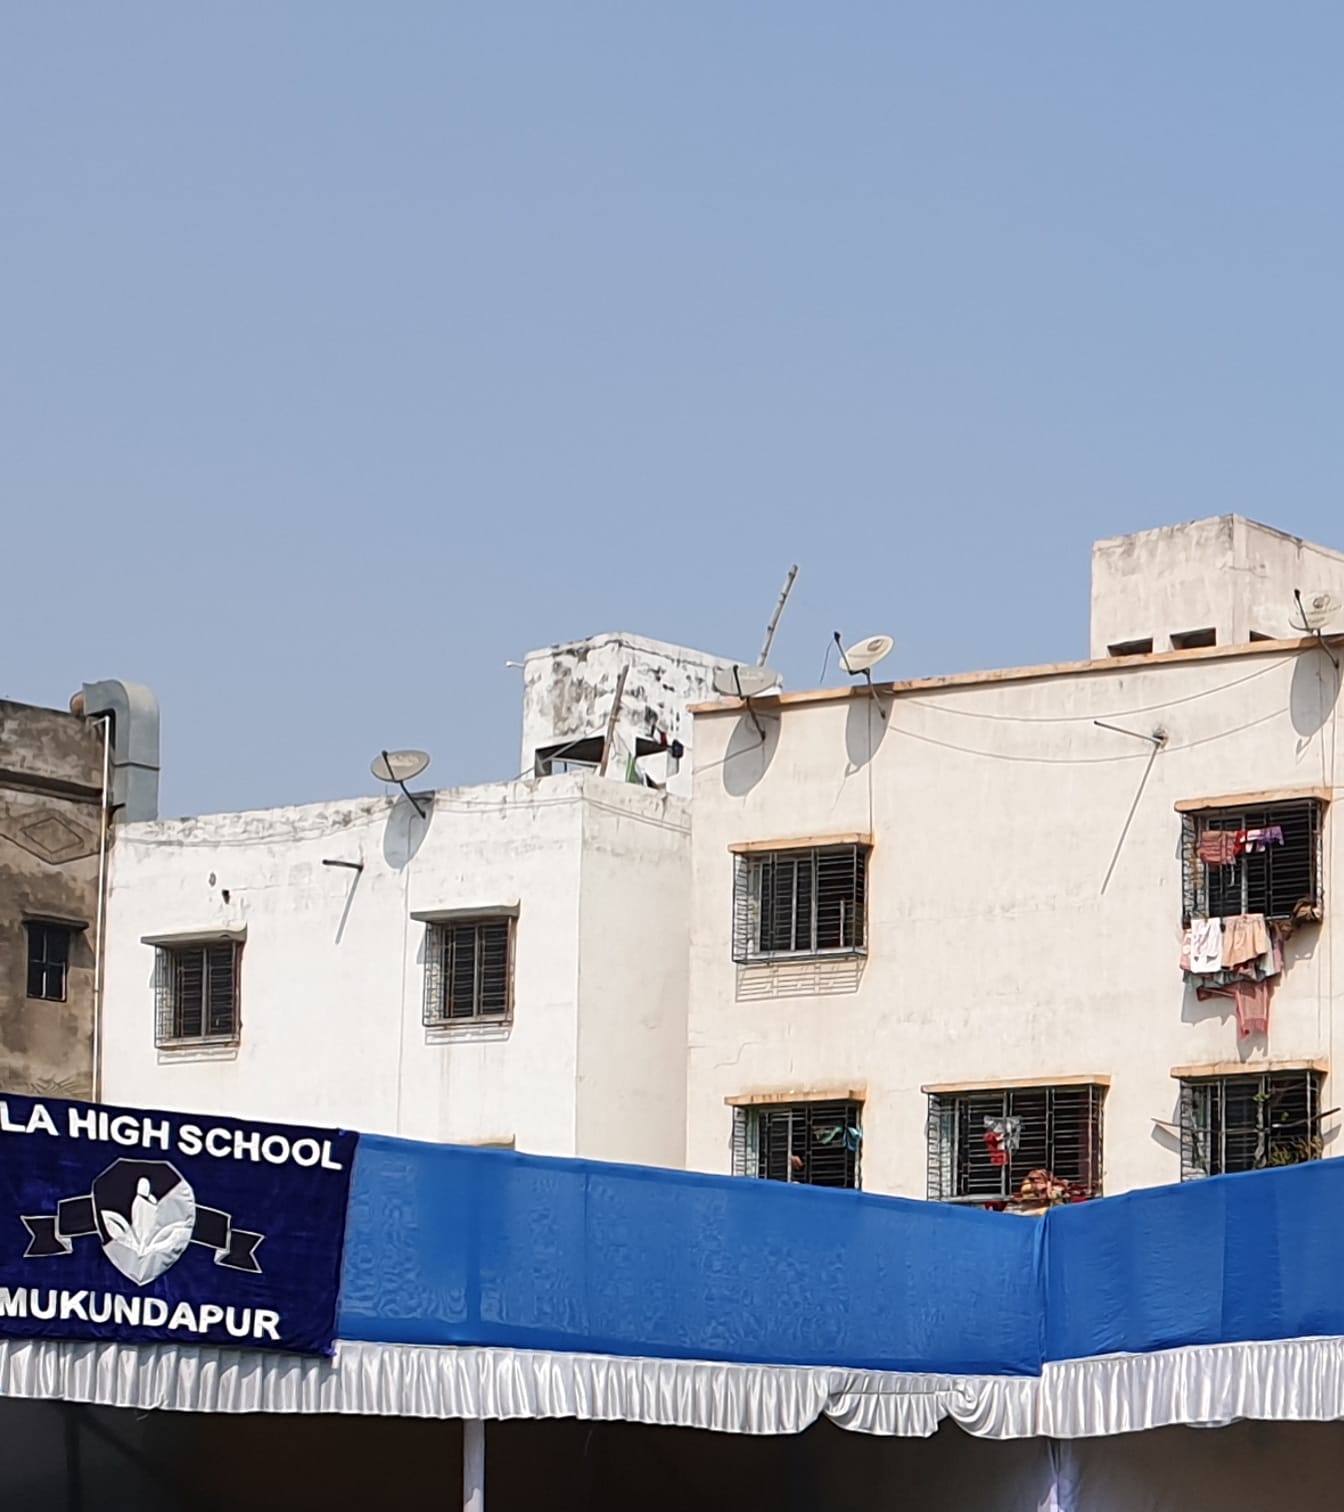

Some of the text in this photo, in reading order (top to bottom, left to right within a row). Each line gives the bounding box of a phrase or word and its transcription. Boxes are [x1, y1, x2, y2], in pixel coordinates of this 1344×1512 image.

[68, 1107, 171, 1151] HIGH
[178, 1124, 343, 1170] SCHOOL
[0, 1287, 282, 1340] MUKUNDAPUR
